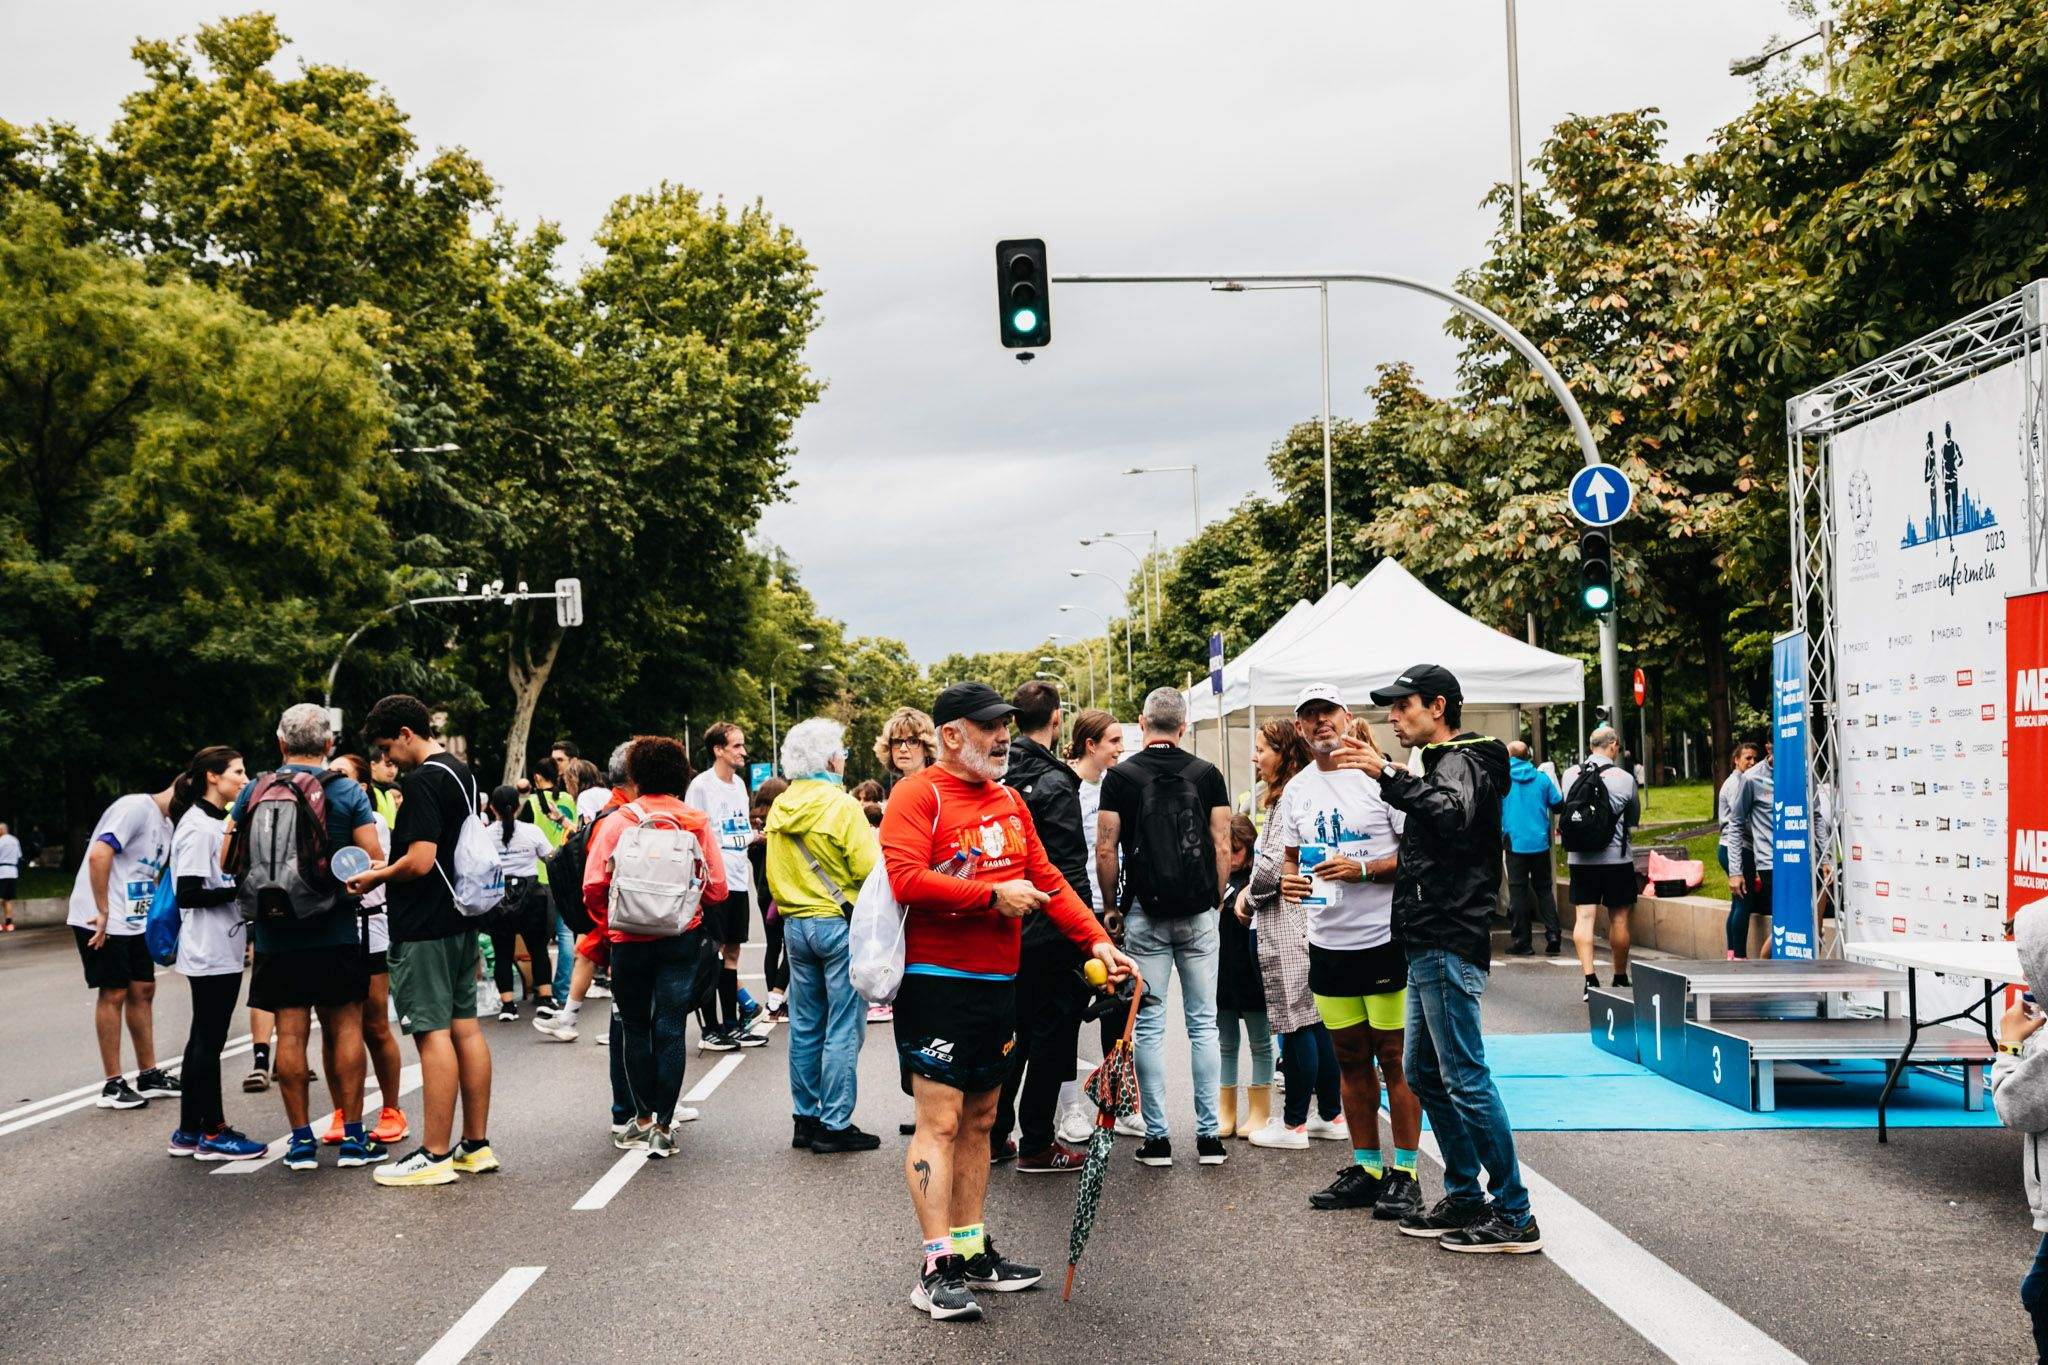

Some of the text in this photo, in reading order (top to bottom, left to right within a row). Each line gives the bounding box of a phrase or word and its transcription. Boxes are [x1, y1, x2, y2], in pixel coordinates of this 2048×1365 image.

[1985, 530, 2006, 552] 2023
[1938, 556, 1996, 596] enfermera
[1937, 627, 1963, 639] MADRID
[2014, 715, 2038, 728] SURGICAL
[2014, 875, 2035, 888] SURGICAL
[1606, 1007, 1615, 1042] 2
[1652, 993, 1662, 1062] 1
[1712, 1045, 1722, 1084] 3
